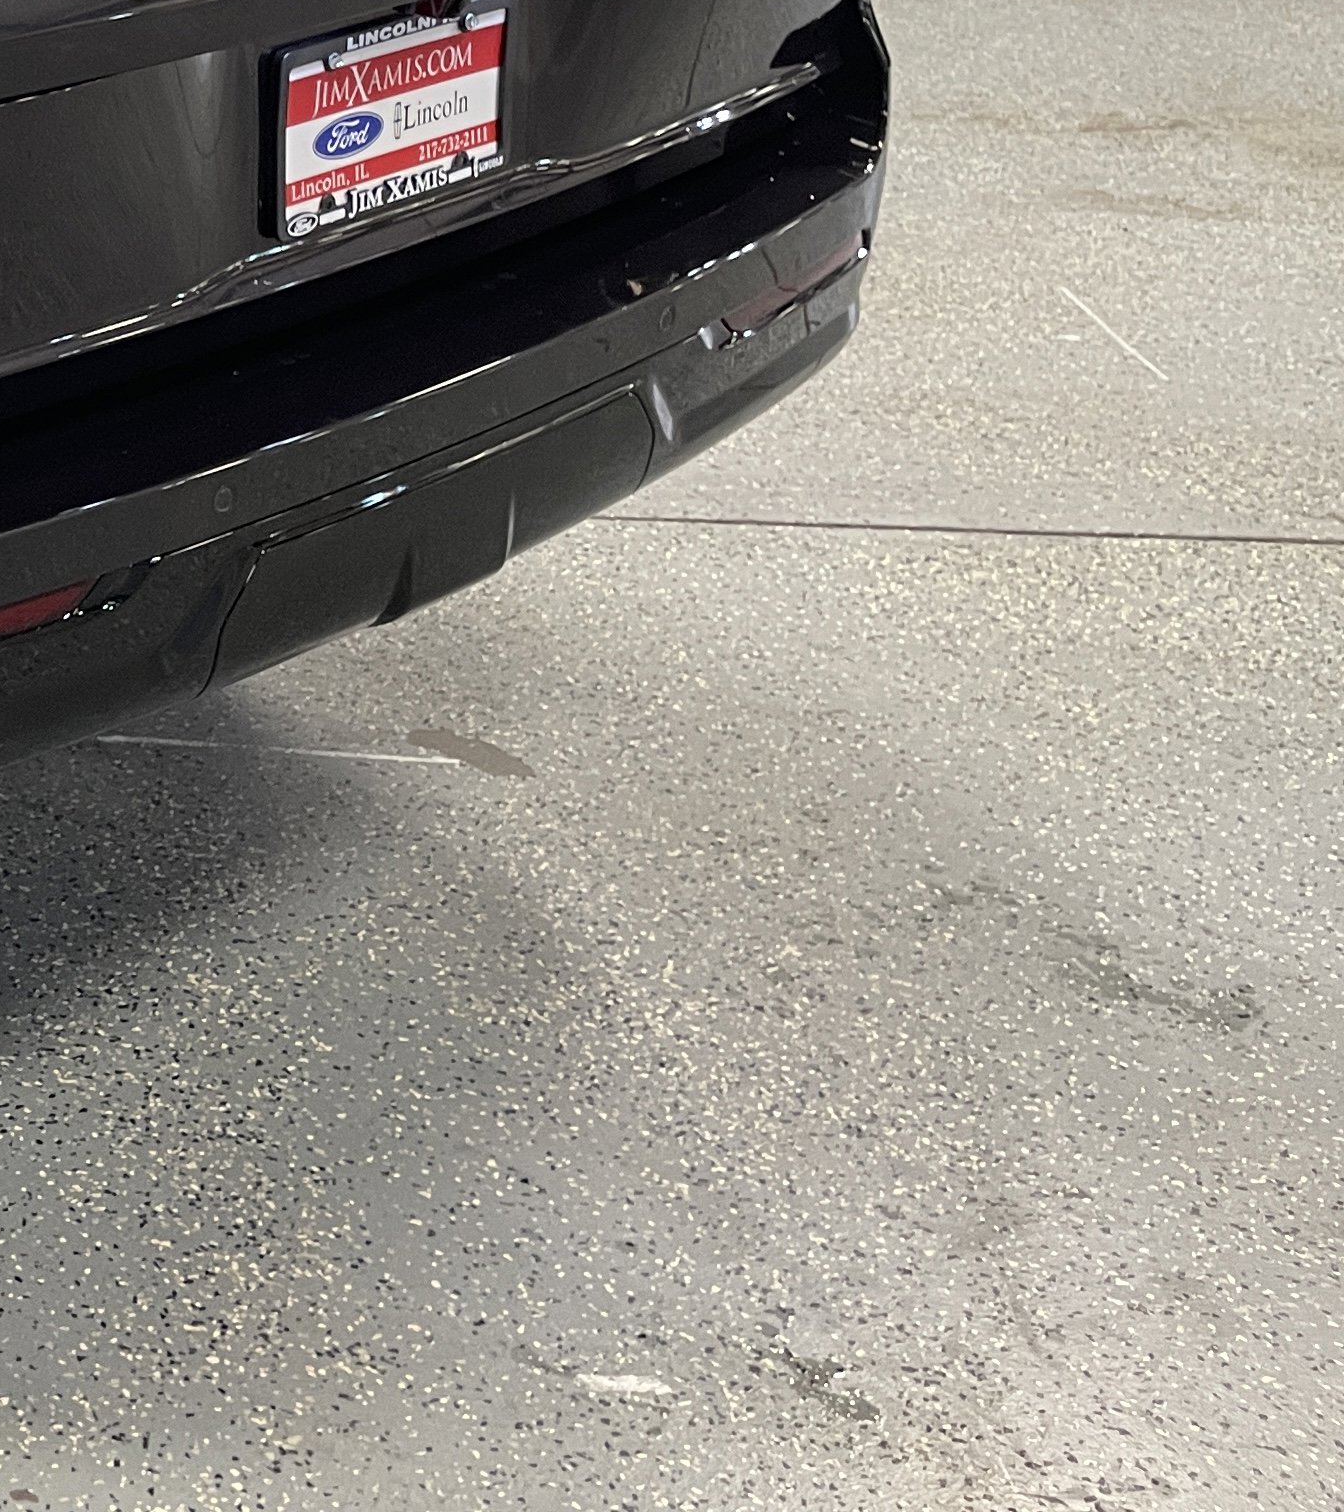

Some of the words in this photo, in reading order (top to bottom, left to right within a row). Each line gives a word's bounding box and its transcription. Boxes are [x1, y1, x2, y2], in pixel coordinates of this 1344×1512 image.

[312, 42, 473, 119] JIMXAMIS.COM
[327, 119, 370, 154] Ford
[403, 90, 469, 133] Lincoln
[419, 126, 488, 162] 217-732-2111
[348, 189, 384, 219] JIM
[385, 168, 448, 205] XAMIS
[355, 163, 370, 182] IL
